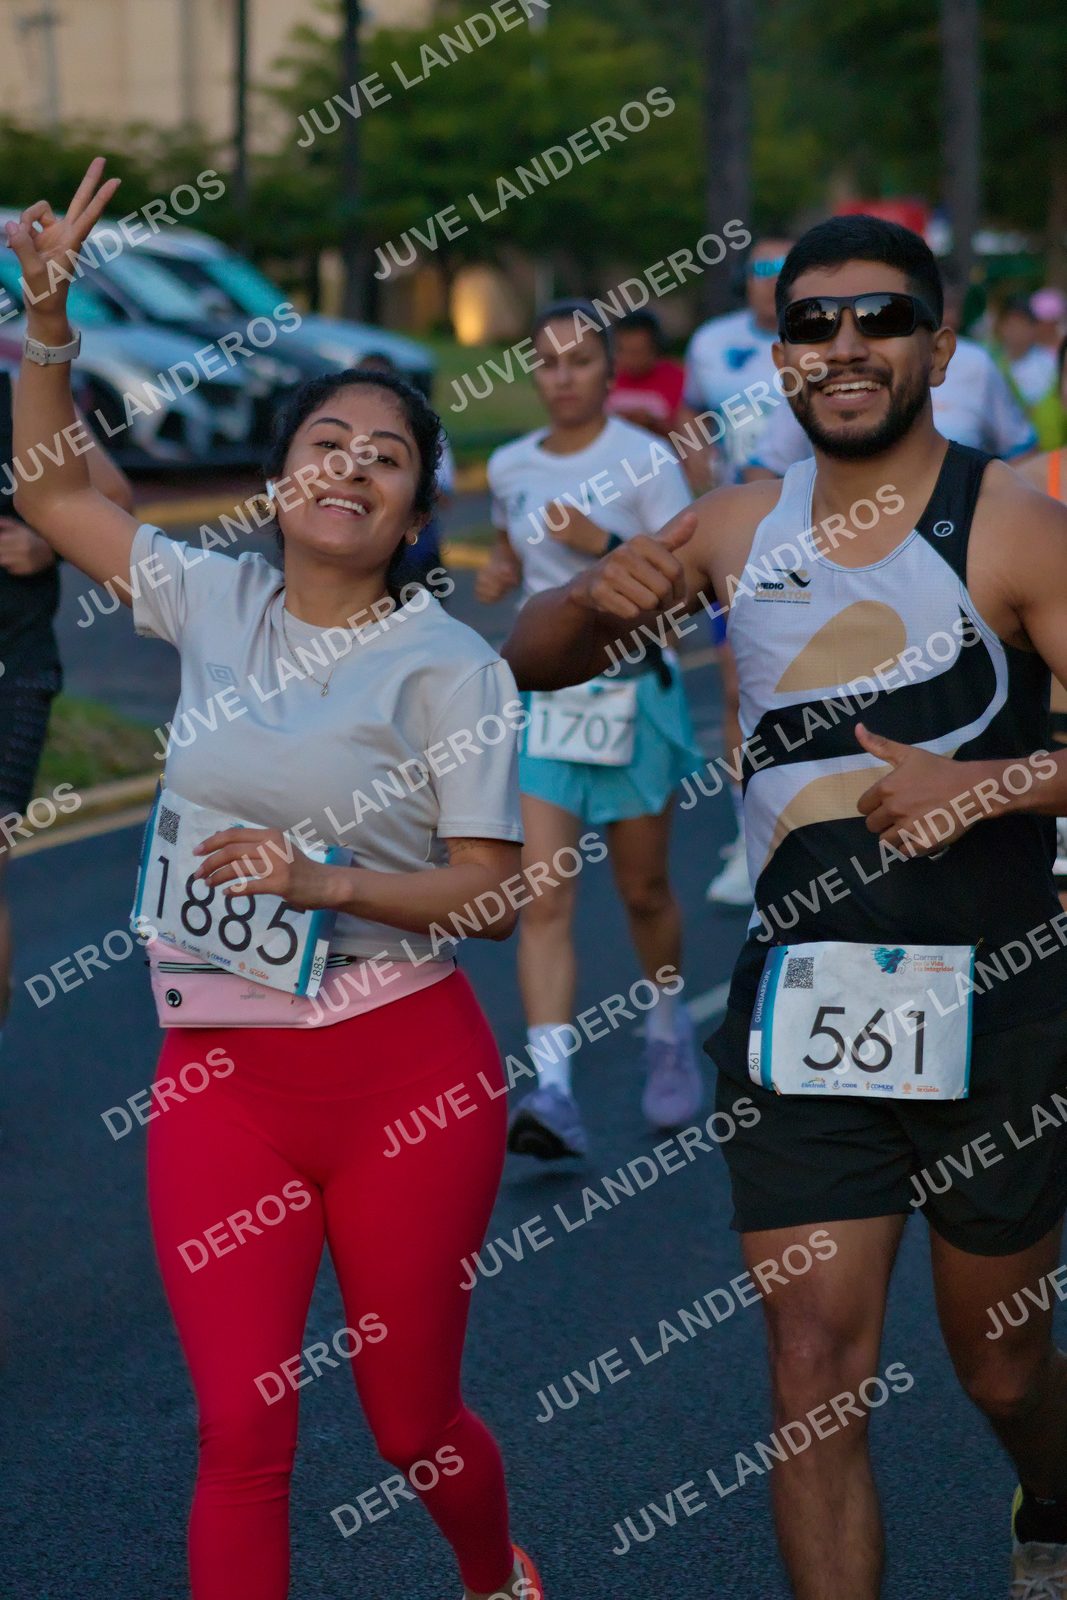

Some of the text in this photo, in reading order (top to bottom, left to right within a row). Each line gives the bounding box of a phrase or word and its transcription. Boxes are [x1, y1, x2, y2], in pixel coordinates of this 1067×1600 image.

[756, 582, 785, 590] MEDIO
[541, 708, 634, 752] 1707
[157, 855, 306, 966] 1885
[310, 955, 325, 983] 1885
[802, 1006, 925, 1075] 561
[749, 1052, 760, 1072] 561
